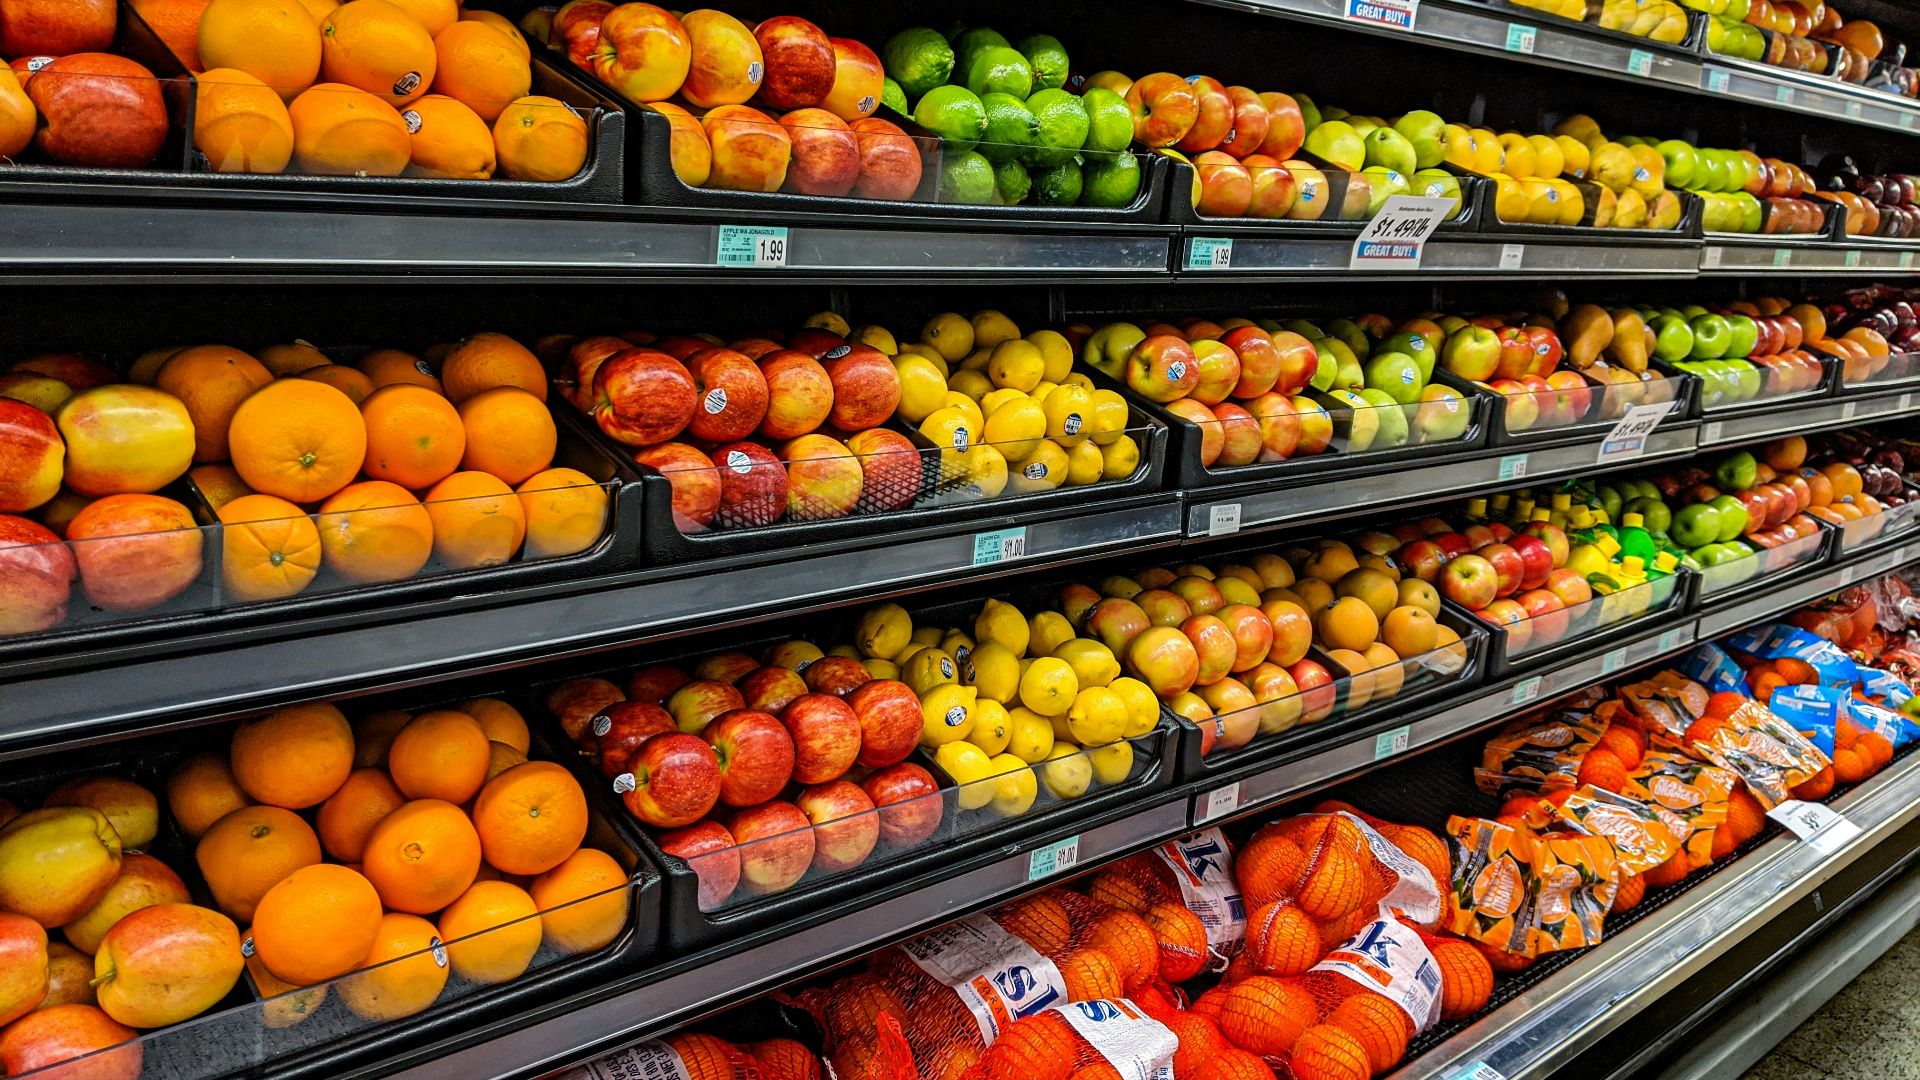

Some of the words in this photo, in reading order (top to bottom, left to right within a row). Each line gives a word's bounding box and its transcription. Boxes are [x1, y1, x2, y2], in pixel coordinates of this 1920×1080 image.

[1356, 4, 1383, 20] GREAT
[1385, 9, 1406, 25] BUY!
[761, 239, 783, 261] 1.99
[1215, 248, 1229, 265] 1.99
[1363, 245, 1390, 257] GREAT
[1392, 245, 1412, 257] BUY!
[659, 1060, 677, 1075] NET
